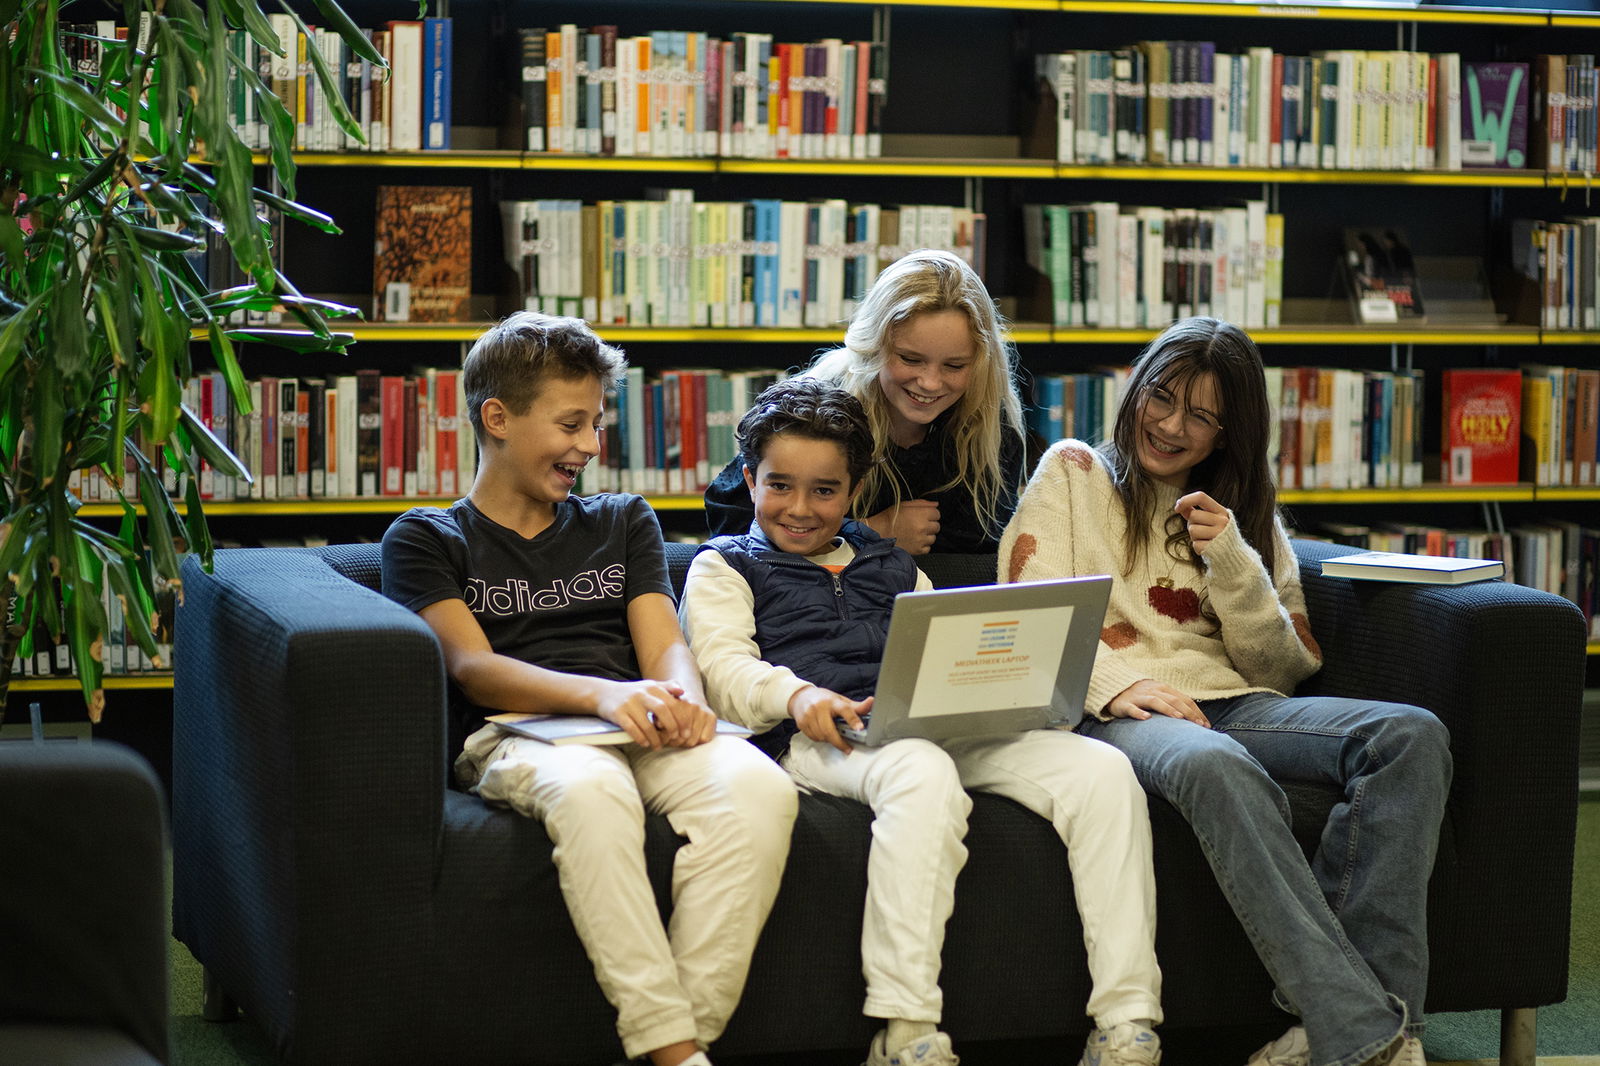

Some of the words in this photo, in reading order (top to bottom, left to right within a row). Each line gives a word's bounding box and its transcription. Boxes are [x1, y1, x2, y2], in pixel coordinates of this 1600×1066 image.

[1461, 415, 1512, 432] HOLY
[464, 563, 626, 616] adidas
[954, 657, 1001, 668] MEDIATHEEK
[1002, 655, 1030, 664] LAPTOP
